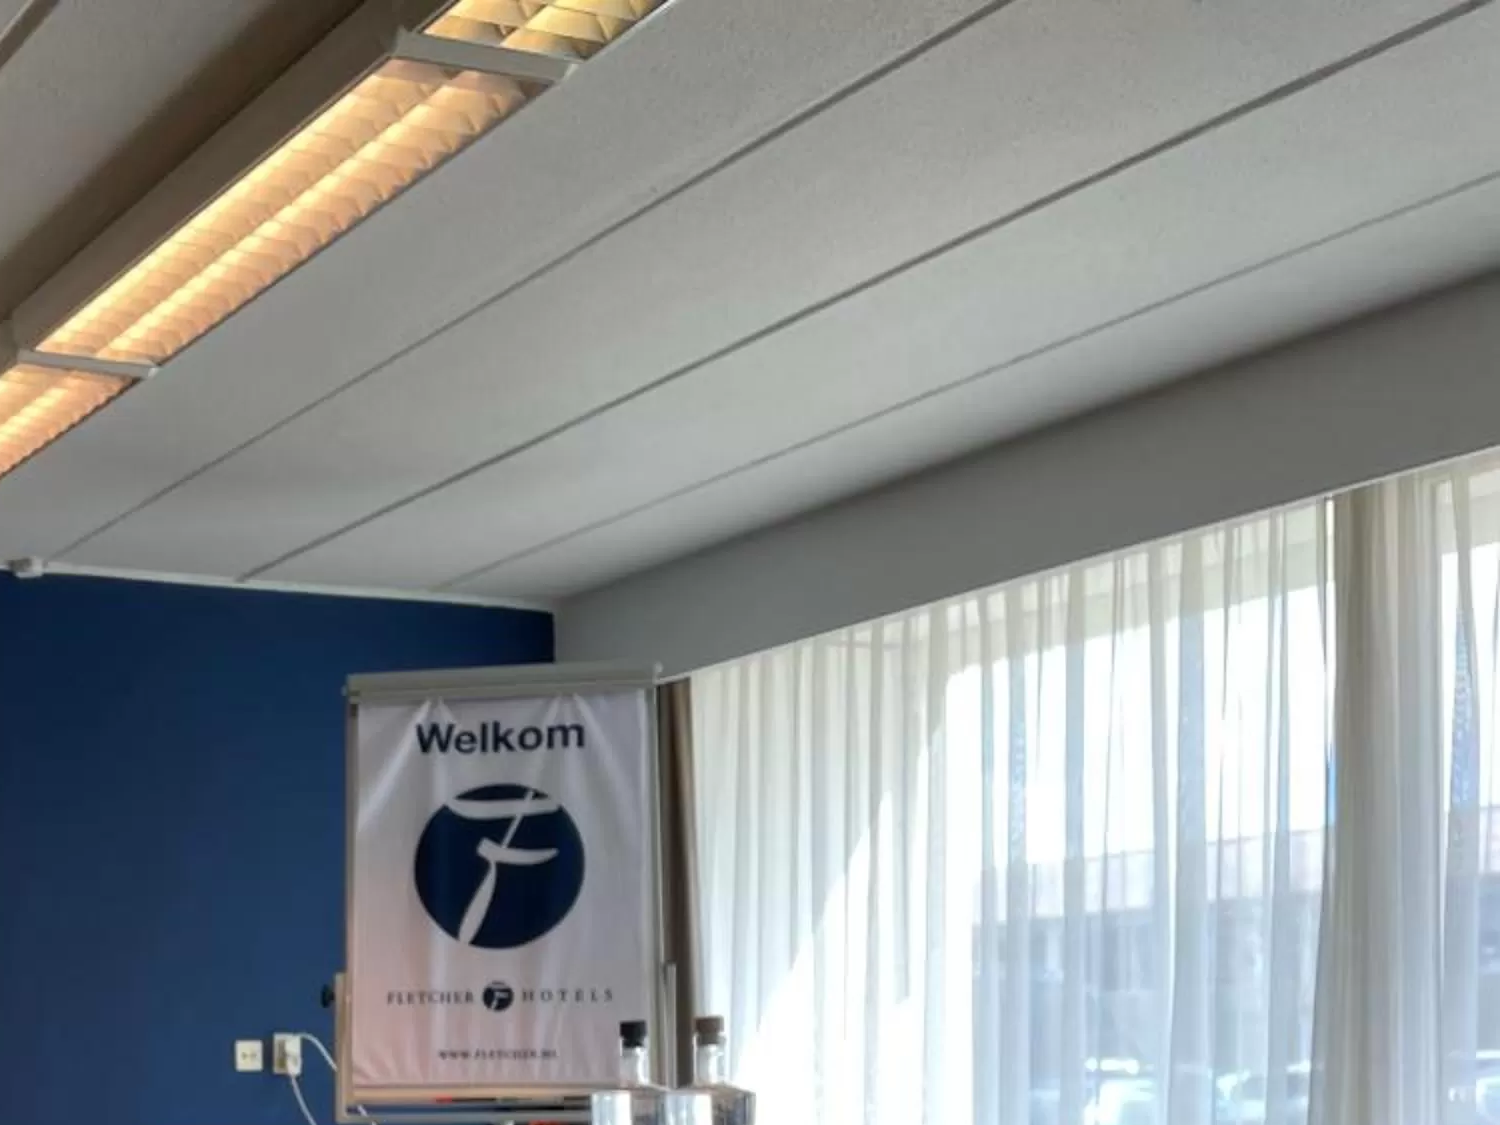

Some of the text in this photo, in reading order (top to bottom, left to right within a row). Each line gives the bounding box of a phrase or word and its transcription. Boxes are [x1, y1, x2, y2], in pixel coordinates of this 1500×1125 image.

[415, 721, 586, 755] Welkom
[387, 988, 474, 1005] FLETCHER
[522, 986, 613, 1002] HOTELS
